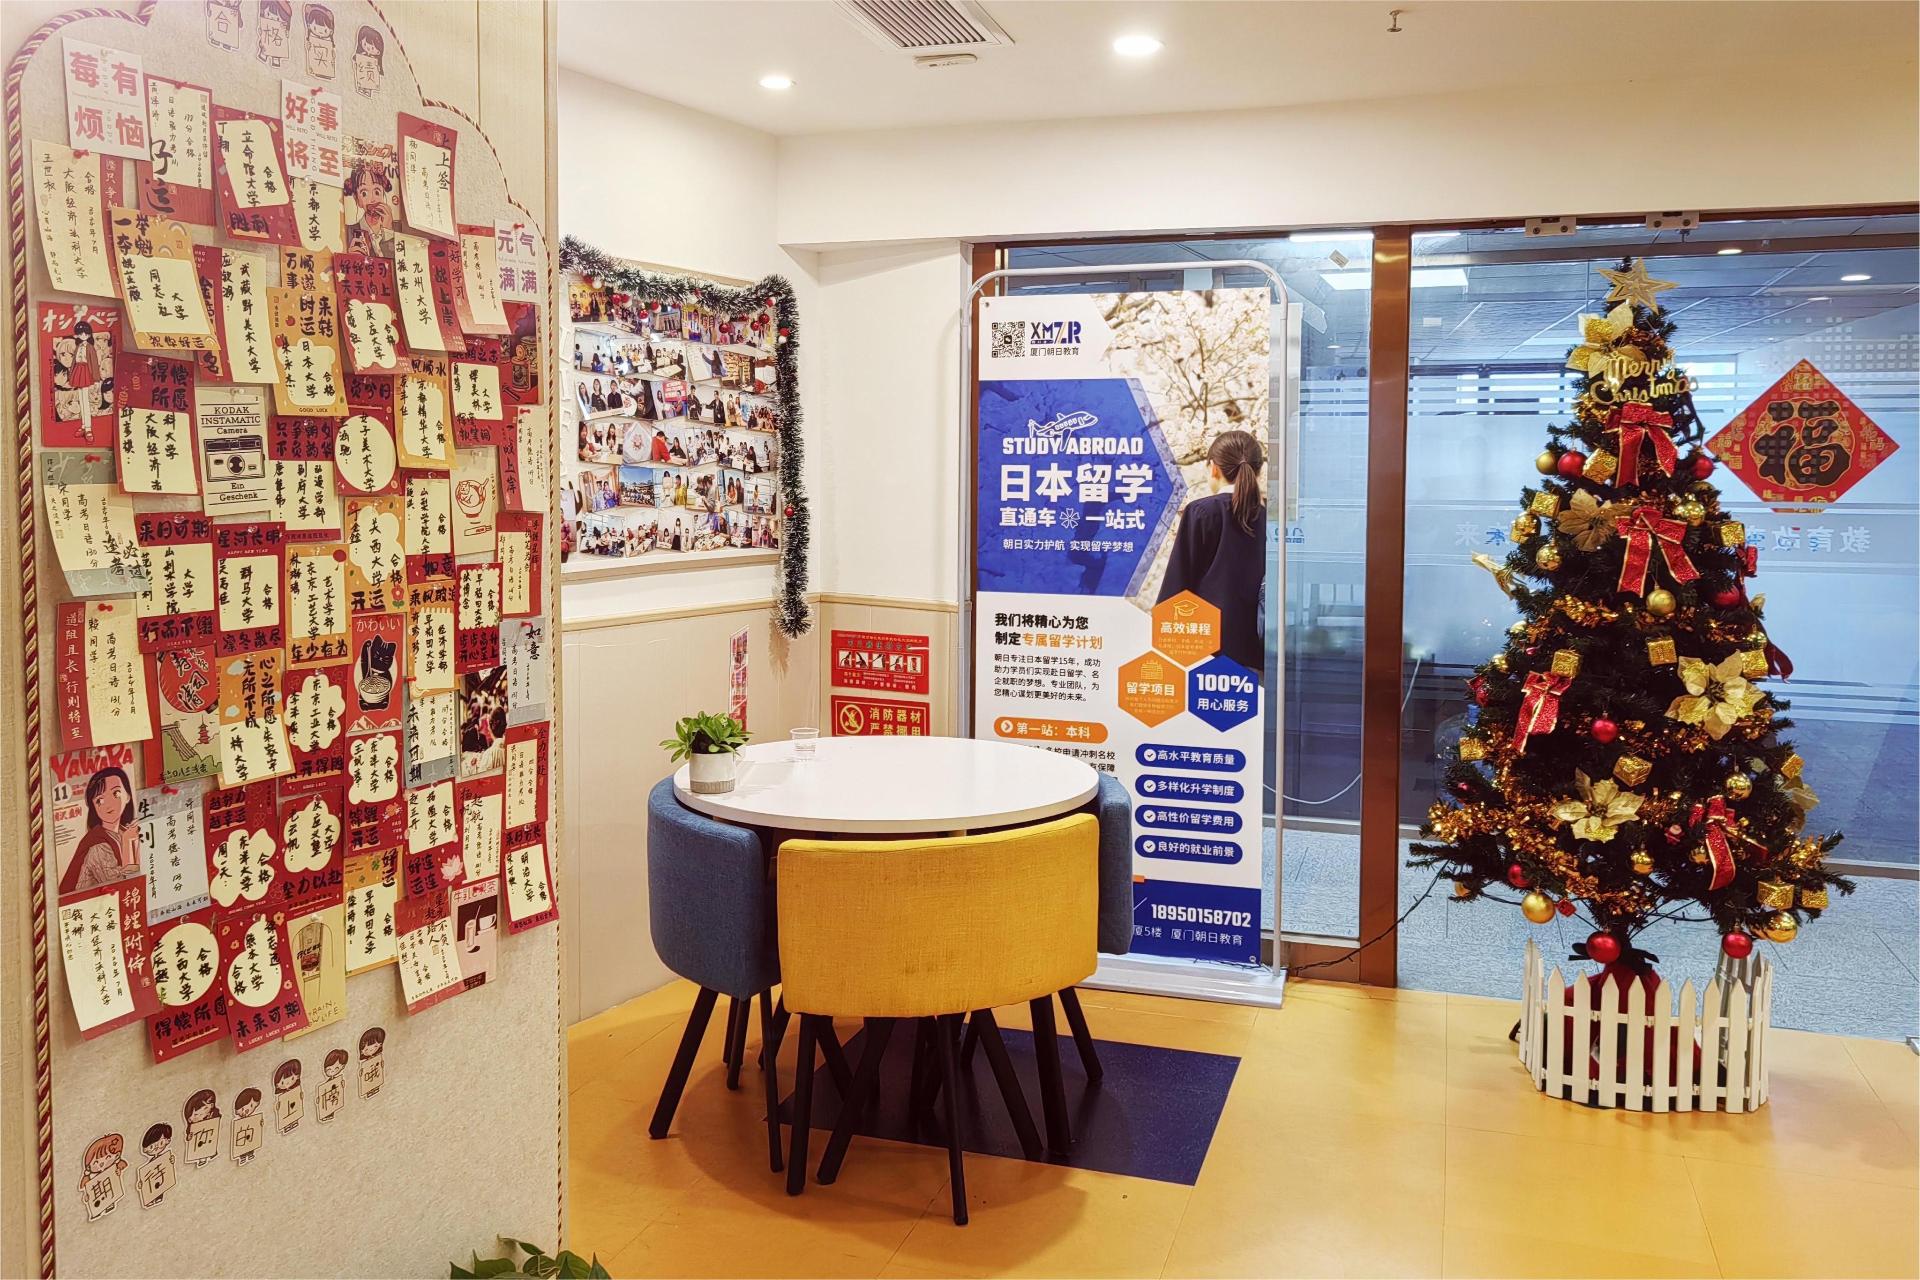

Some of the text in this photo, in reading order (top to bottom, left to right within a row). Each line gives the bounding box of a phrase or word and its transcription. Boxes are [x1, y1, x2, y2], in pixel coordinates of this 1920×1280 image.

[214, 12, 230, 33] 合
[263, 25, 282, 47] 格
[314, 45, 329, 68] 实
[359, 60, 375, 84] 绩
[308, 183, 321, 241] 京都大学
[412, 262, 432, 325] 九州大学
[171, 292, 189, 321] 大学
[1030, 347, 1079, 356] 厦门朝日教育
[302, 340, 318, 398] 日本大学
[1604, 348, 1676, 391] Merry
[323, 371, 335, 397] 合格
[1590, 376, 1699, 405] Christmas
[482, 389, 492, 413] 大学
[201, 416, 261, 425] INSTAMATIC
[436, 420, 446, 445] 合格
[360, 412, 375, 493] 女子美术大学
[1002, 436, 1144, 455] STUDY ABROAD
[1753, 400, 1851, 488] 福
[1000, 462, 1153, 503] 日本留学
[220, 493, 258, 501] Geschenk
[438, 513, 446, 535] 合格
[999, 507, 1145, 529] 直通车 一站式
[140, 518, 211, 543] 来日可期
[1002, 538, 1134, 553] 朝日实力护航 实现留学梦想
[390, 553, 403, 587] 合格
[182, 568, 195, 598] 大学
[262, 583, 274, 610] 合格
[307, 562, 320, 640] 东京工艺大学
[323, 576, 335, 635] 艺术学部
[350, 589, 386, 610] 开运
[356, 616, 400, 632] かわいい
[995, 613, 1089, 630] 我们将精心为您
[1160, 622, 1212, 636] 高效课程
[291, 639, 348, 661] 年少有为
[424, 614, 435, 674] 早稻田大学
[438, 624, 448, 673] 经济学部
[526, 625, 541, 660] 如意
[995, 632, 1103, 650] 制定专属留学计划
[1126, 682, 1175, 696] 留学项目
[1196, 674, 1254, 694] 100%
[870, 707, 921, 723] 消防器材
[1197, 698, 1249, 712] 用心服务
[327, 707, 337, 731] 合格
[50, 742, 135, 783] YAWARA
[384, 756, 394, 783] 合格
[1157, 751, 1235, 766] 高水平教育质量
[54, 785, 68, 801] 11
[1158, 780, 1235, 796] 多样化升学制度
[443, 804, 453, 832] 合格
[1157, 811, 1234, 827] 高性价留学费用
[324, 824, 336, 853] 大学
[1158, 841, 1235, 858] 良好的就业前景
[257, 852, 273, 885] 合格
[364, 890, 376, 955] 早稻田大学
[383, 913, 393, 936] 合格
[1151, 904, 1252, 927] 18950158702
[1171, 928, 1243, 946] 厦门朝日教育
[197, 948, 214, 978] 合格
[232, 964, 247, 996] 合格
[249, 1021, 297, 1045] LUCKY LUCKY LUCKY
[283, 1100, 297, 1117] 上
[321, 1088, 339, 1111] 榜
[194, 1128, 215, 1152] 你
[236, 1127, 254, 1147] 的
[91, 1176, 115, 1201] 期
[144, 1163, 167, 1193] 待
